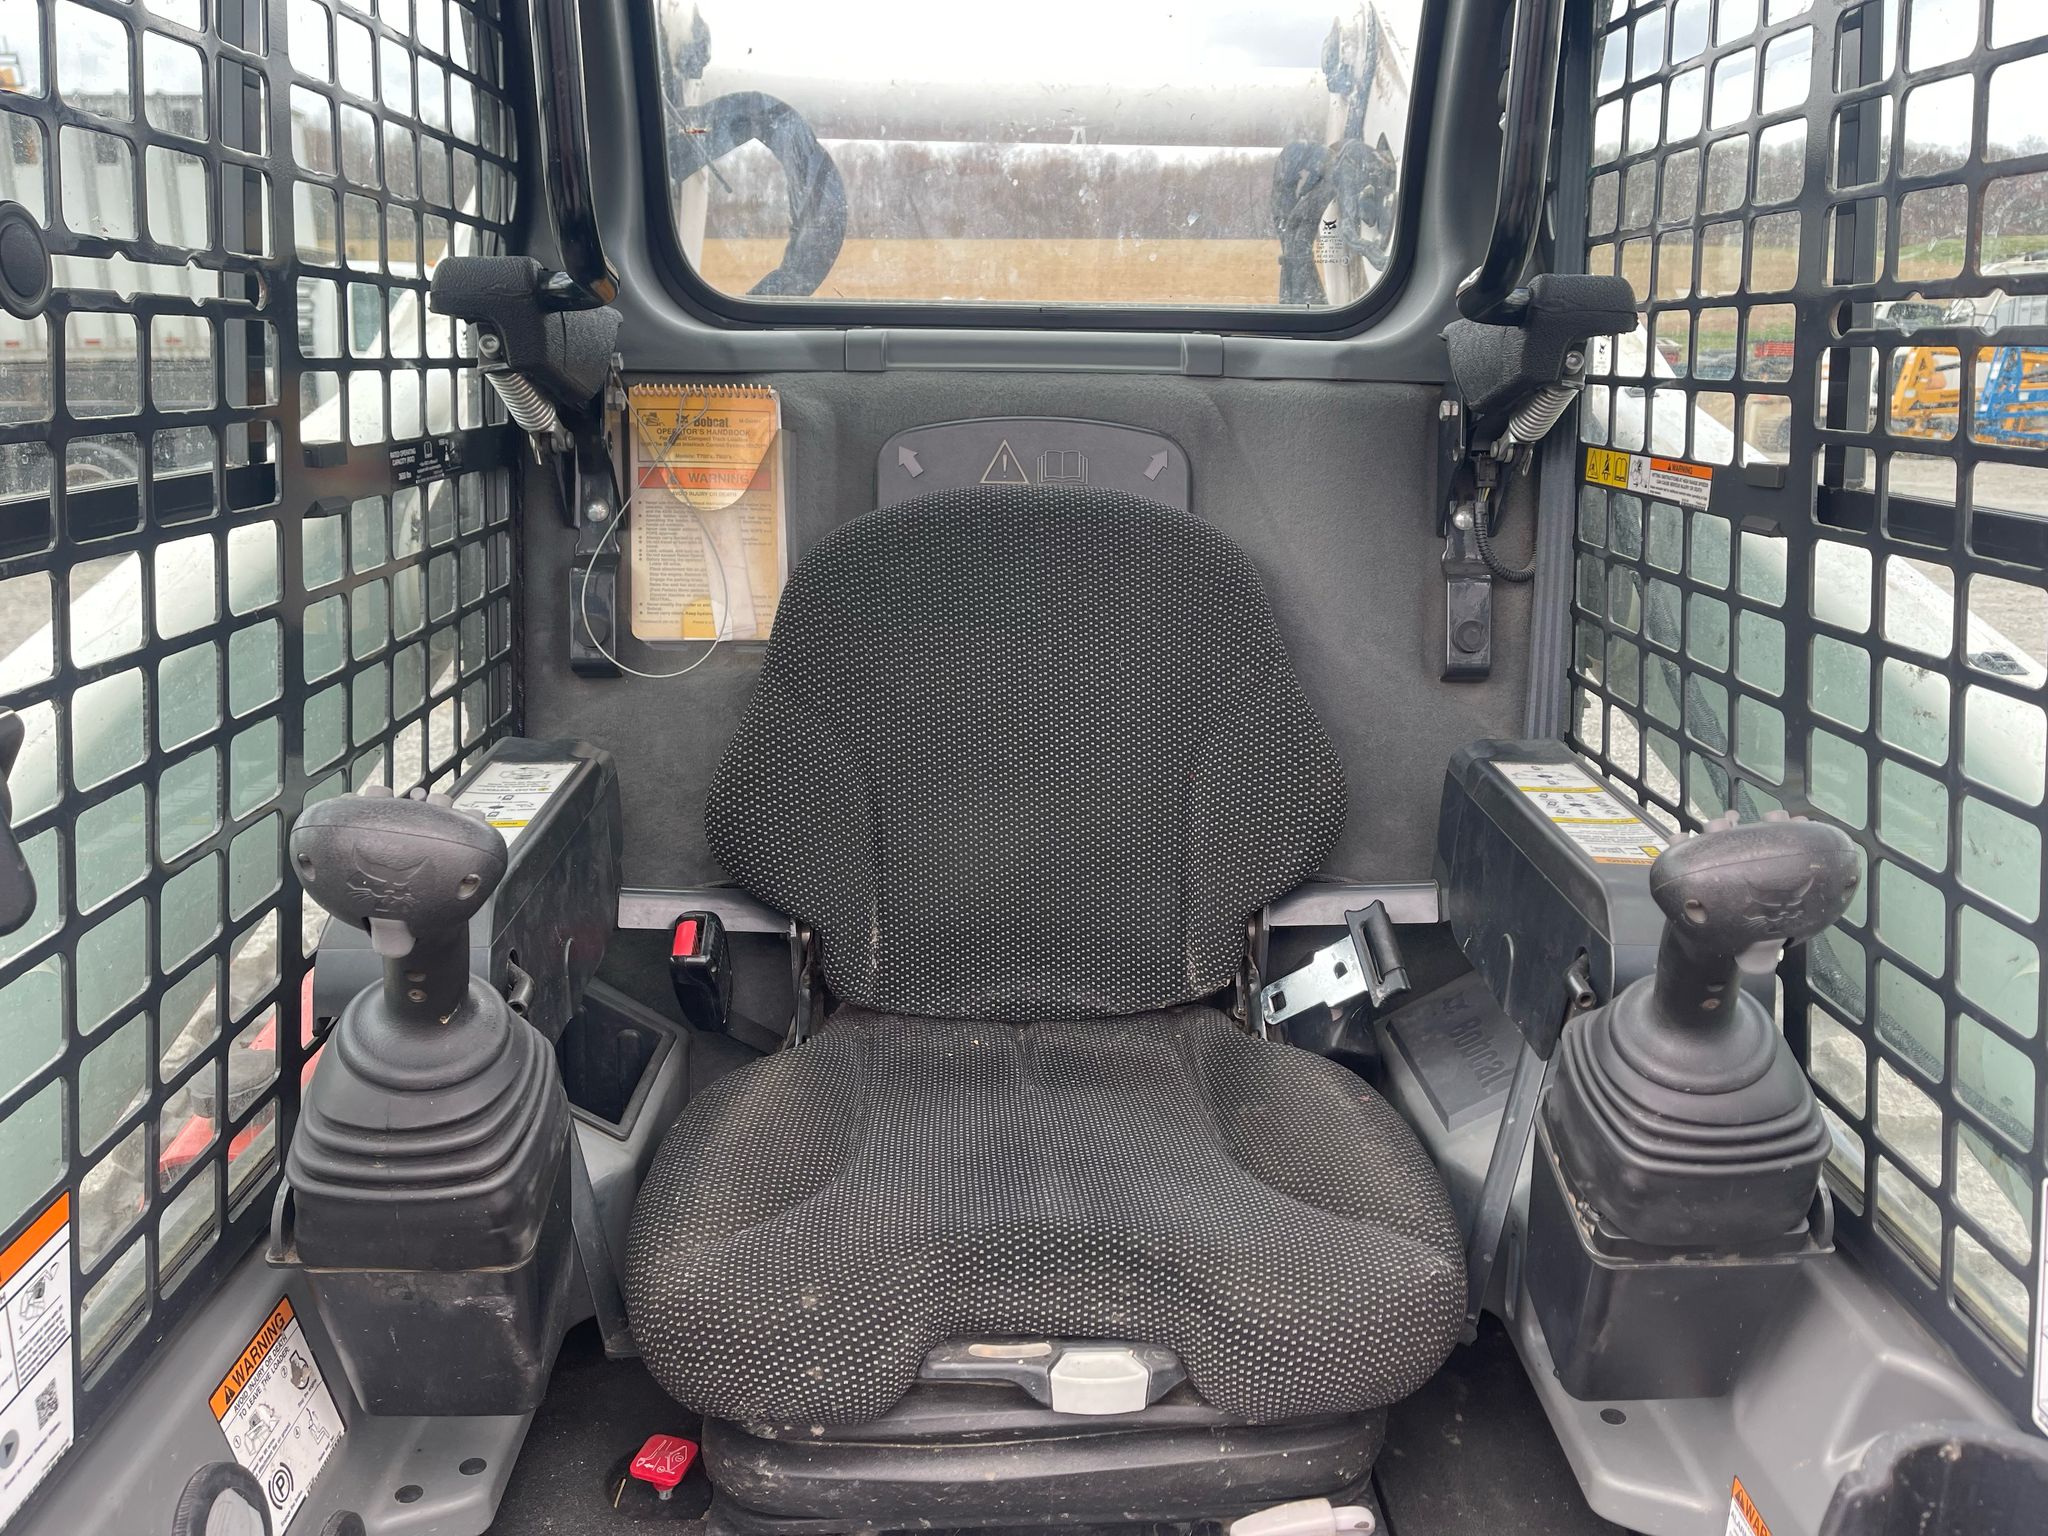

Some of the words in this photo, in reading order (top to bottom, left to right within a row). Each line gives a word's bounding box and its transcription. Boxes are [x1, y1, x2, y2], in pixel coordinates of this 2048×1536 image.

[693, 415, 729, 428] Bobcat
[706, 428, 751, 437] HANDBOOK
[688, 472, 750, 485] WARNING
[1447, 1015, 1515, 1090] Bobcat
[232, 1313, 285, 1388] WARNING
[233, 1390, 249, 1413] AVOID
[248, 1368, 266, 1391] INJURY
[264, 1354, 273, 1369] OR
[272, 1335, 288, 1356] DEATH
[238, 1406, 247, 1420] TO
[247, 1387, 263, 1410] LEAVE
[261, 1372, 272, 1388] THE
[275, 1474, 285, 1498] P
